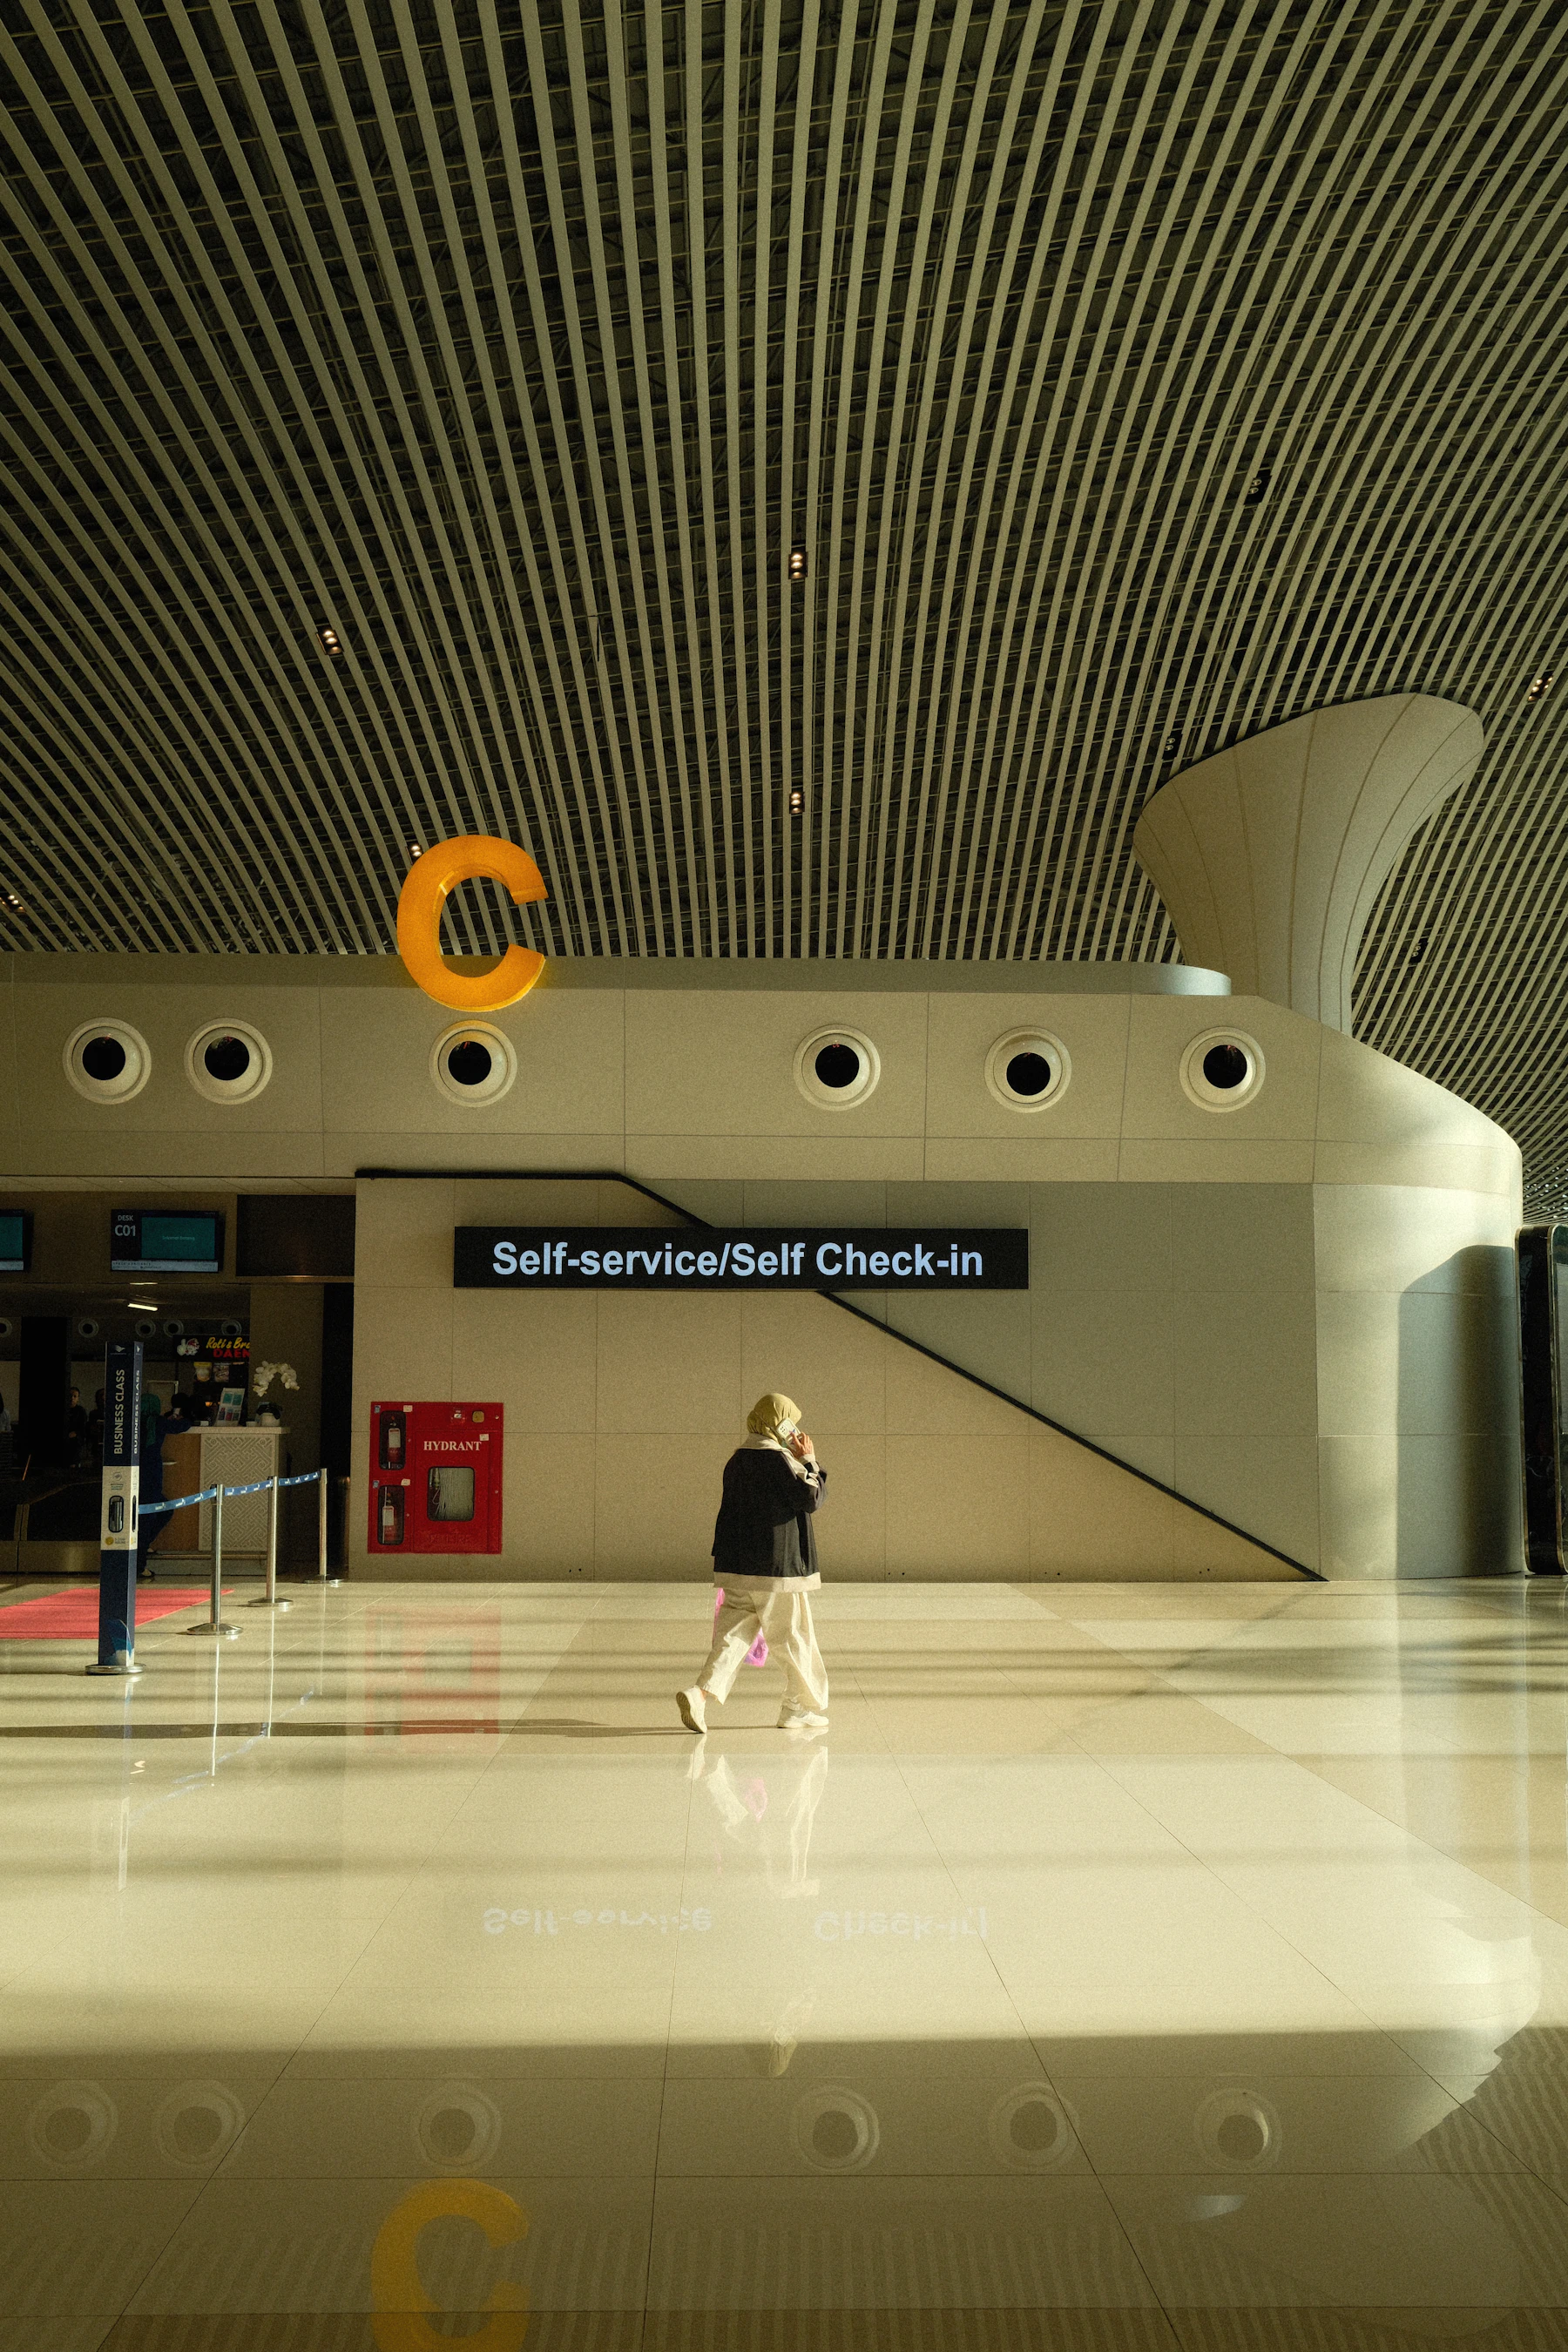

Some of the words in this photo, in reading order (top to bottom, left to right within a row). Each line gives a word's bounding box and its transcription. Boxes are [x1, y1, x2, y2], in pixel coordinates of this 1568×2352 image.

[396, 834, 549, 1012] C
[114, 1224, 136, 1237] C01
[492, 1241, 806, 1276] Self-service/Self
[816, 1241, 983, 1276] Check-in
[206, 1337, 226, 1349] Roti
[115, 1369, 125, 1402] CLASS
[114, 1403, 124, 1454] BUSINESS
[423, 1441, 482, 1451] HYDRANT
